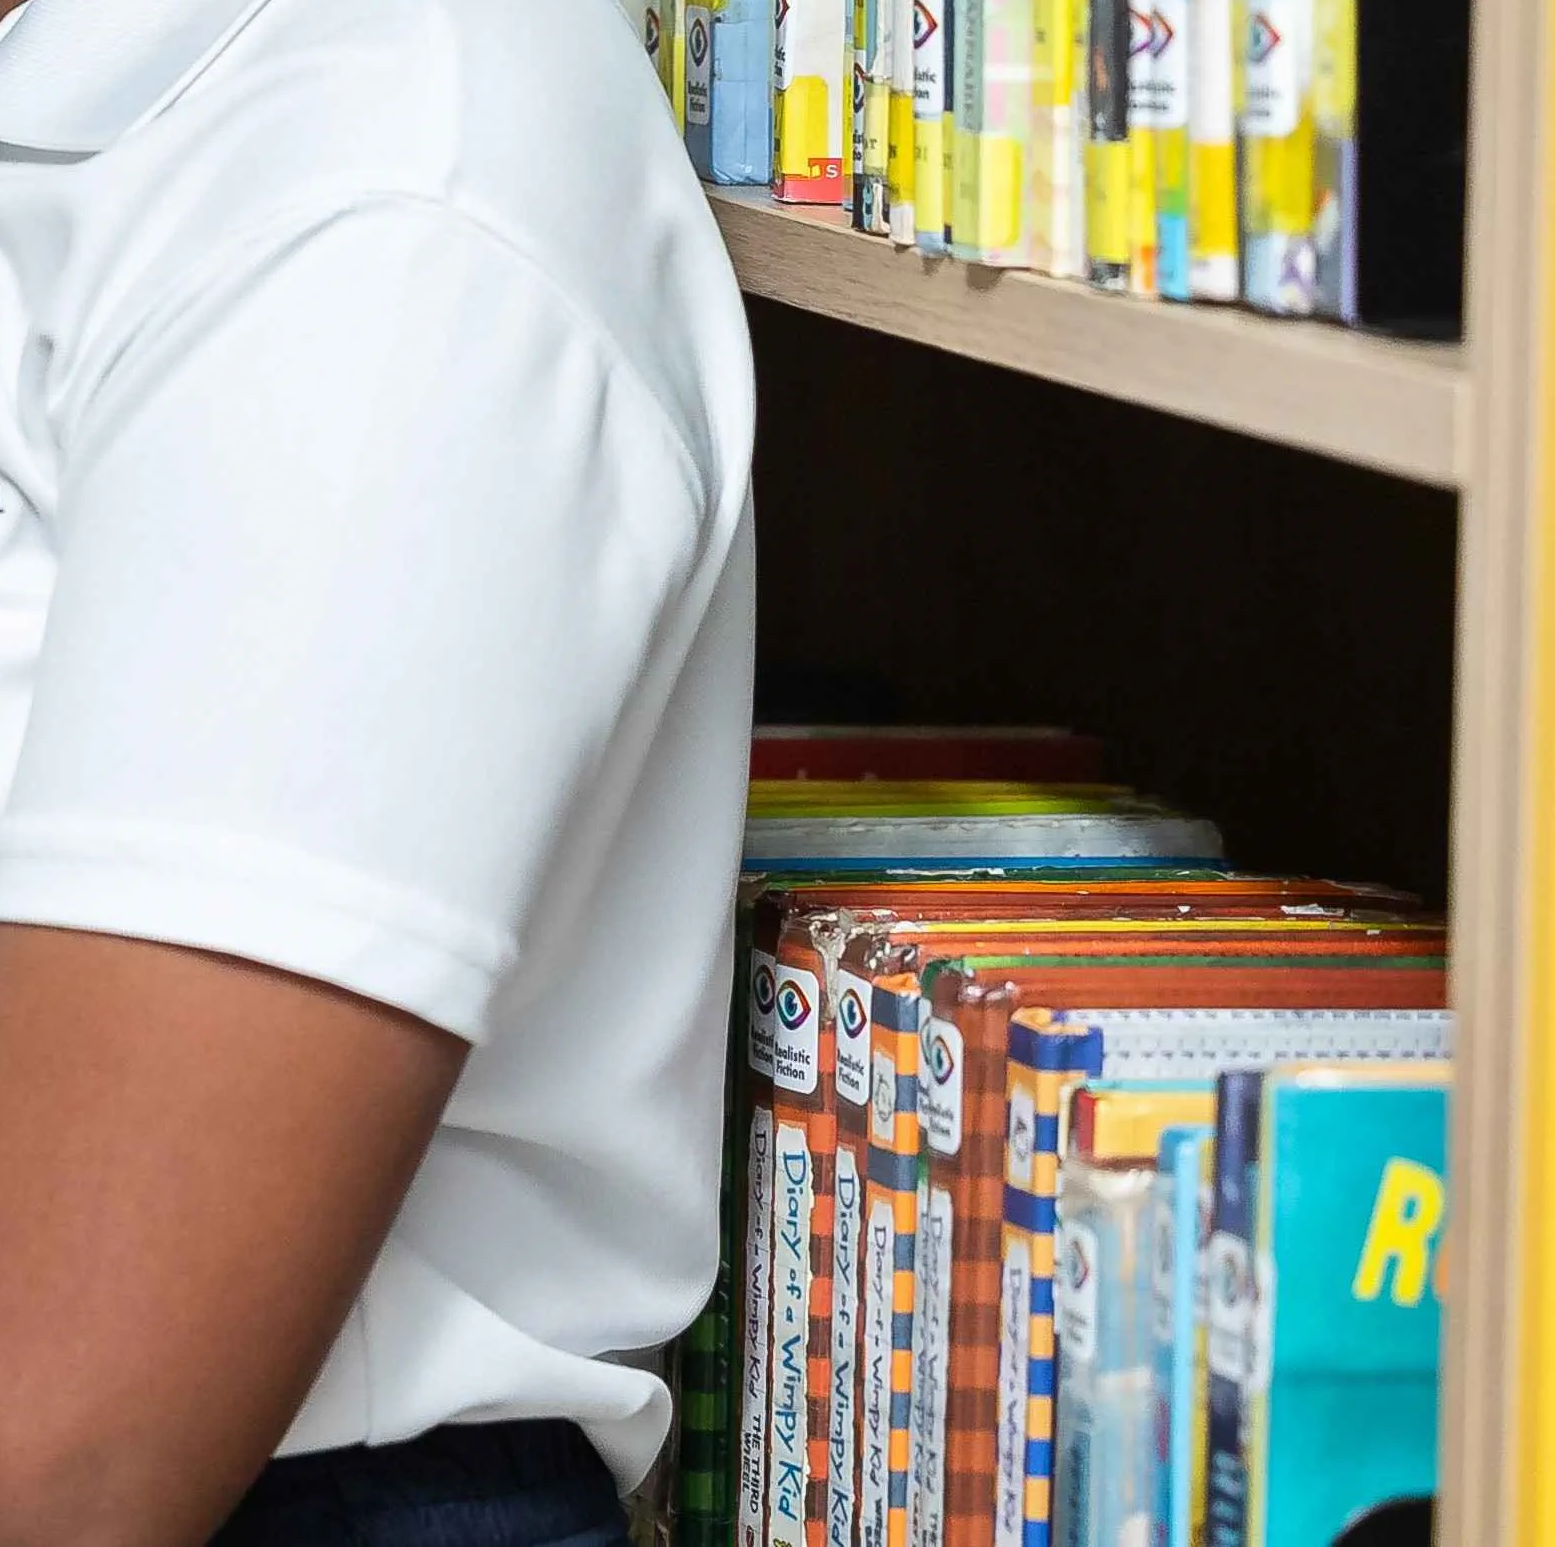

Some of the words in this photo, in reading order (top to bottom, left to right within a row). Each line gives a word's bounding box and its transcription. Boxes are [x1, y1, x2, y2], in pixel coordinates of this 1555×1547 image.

[754, 1130, 767, 1210] Diary
[781, 1150, 807, 1262] Diary
[836, 1174, 856, 1286] Diary
[1351, 1156, 1448, 1308] R
[786, 1269, 802, 1300] of
[873, 1226, 887, 1302] Diary
[748, 1264, 763, 1351] Wimpy
[785, 1306, 794, 1324] a
[748, 1356, 762, 1399] Kid
[775, 1335, 802, 1453] Wimpy
[869, 1355, 883, 1440] Wimpy
[751, 1413, 762, 1451] THE
[831, 1360, 849, 1481] Wimpy
[741, 1431, 752, 1493] WHEEL
[749, 1456, 761, 1514] THIRD
[778, 1461, 803, 1521] Kid
[870, 1444, 883, 1487] Kid
[831, 1487, 849, 1547] Kid
